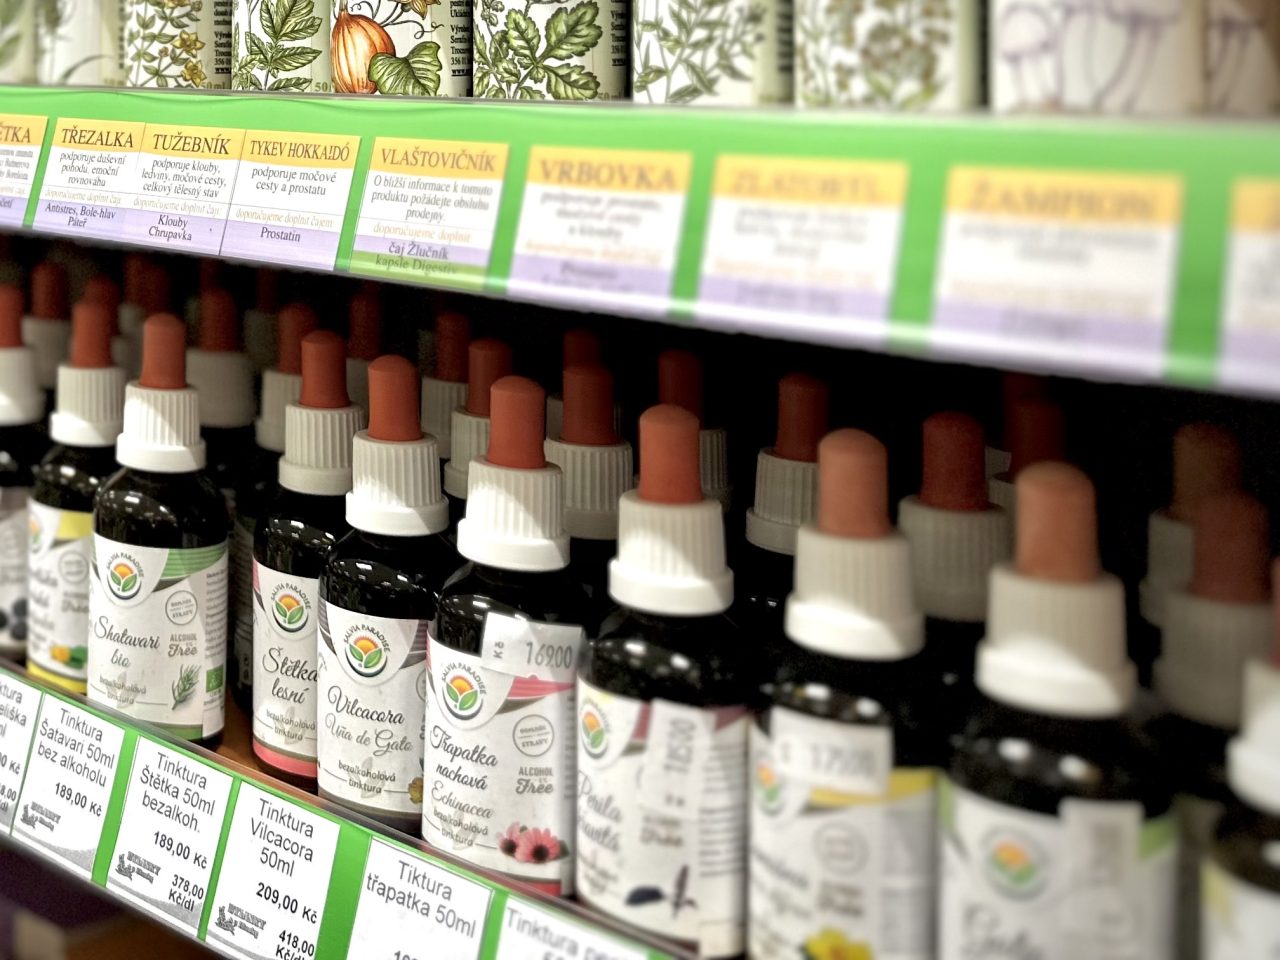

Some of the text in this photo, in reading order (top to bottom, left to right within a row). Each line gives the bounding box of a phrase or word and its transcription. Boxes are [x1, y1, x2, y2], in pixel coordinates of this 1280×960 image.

[61, 125, 133, 148] TŘEZALKA
[153, 131, 231, 155] TUŽEBNÍK
[250, 140, 287, 157] TYKEV
[60, 151, 126, 165] podporuje duševní
[61, 163, 119, 177] pohodu, emoční
[152, 158, 221, 174] podporuje klouby,
[381, 146, 496, 172] VLAŠTOVIČNÍK
[68, 175, 106, 187] rovnováhu
[141, 168, 227, 188] ledviny, močové cesty,
[251, 166, 337, 183] podporuje močové
[373, 175, 382, 186] O
[383, 176, 405, 189] bližší
[408, 177, 450, 193] informace
[461, 185, 493, 196] tomuto
[540, 158, 678, 191] VRBOVKA
[142, 183, 219, 199] celkový tělesný stav
[255, 181, 279, 194] cesty
[288, 183, 326, 196] prostatu
[371, 190, 489, 211] produktu požádejte obsluhu
[45, 202, 115, 220] Antistres, Bole-hlav
[67, 216, 87, 228] Páteř
[158, 214, 188, 229] Klouby
[405, 208, 446, 224] prodejny.
[148, 225, 192, 242] Chrupavka
[260, 226, 301, 243] Prostatin
[375, 253, 409, 271] kapsle
[388, 240, 449, 260] čaj Žlučník
[270, 582, 311, 610] SALVIA PARADISE
[94, 616, 160, 649] Shatavari
[170, 633, 197, 642] ALCOHOL
[343, 623, 391, 653] SALVIA PARADISE
[110, 649, 130, 669] bio
[168, 643, 198, 657] Free
[262, 647, 318, 683] Štětka
[441, 662, 487, 695] SALVIA PARADISE
[271, 678, 309, 704] lesní
[327, 685, 405, 725] Vilcacora
[60, 707, 103, 743] Tinktura
[274, 725, 303, 741] tinktura
[325, 712, 413, 757] Uña de Gato
[39, 718, 115, 770] Šatavari 50ml
[9, 760, 21, 775] Kč
[38, 741, 107, 787] bez alkoholu
[157, 751, 207, 790] Tinktura
[338, 759, 396, 783] bezalkoholová
[518, 766, 554, 777] ALCOHOL
[348, 778, 382, 795] tinktura
[436, 762, 488, 791] nachová
[515, 778, 554, 795] Free
[55, 782, 102, 817] 189,00 Kč
[140, 765, 216, 817] Štětka 50ml
[431, 780, 493, 820] Echinacea
[142, 790, 201, 833] bezalkoh.
[259, 797, 314, 839] Tinktura
[251, 817, 314, 863] Vilcacora
[441, 828, 474, 847] tinktura
[153, 831, 208, 870] 189,00 Kč
[259, 846, 295, 877] 50ml
[171, 874, 204, 900] 378,00
[399, 860, 453, 901] Tiktura
[168, 888, 195, 912] Kč/dl
[256, 882, 318, 925] 209,00 Kč
[366, 872, 476, 939] třapatka 50ml
[278, 929, 315, 957] 418,00
[507, 906, 579, 956] Tinktura
